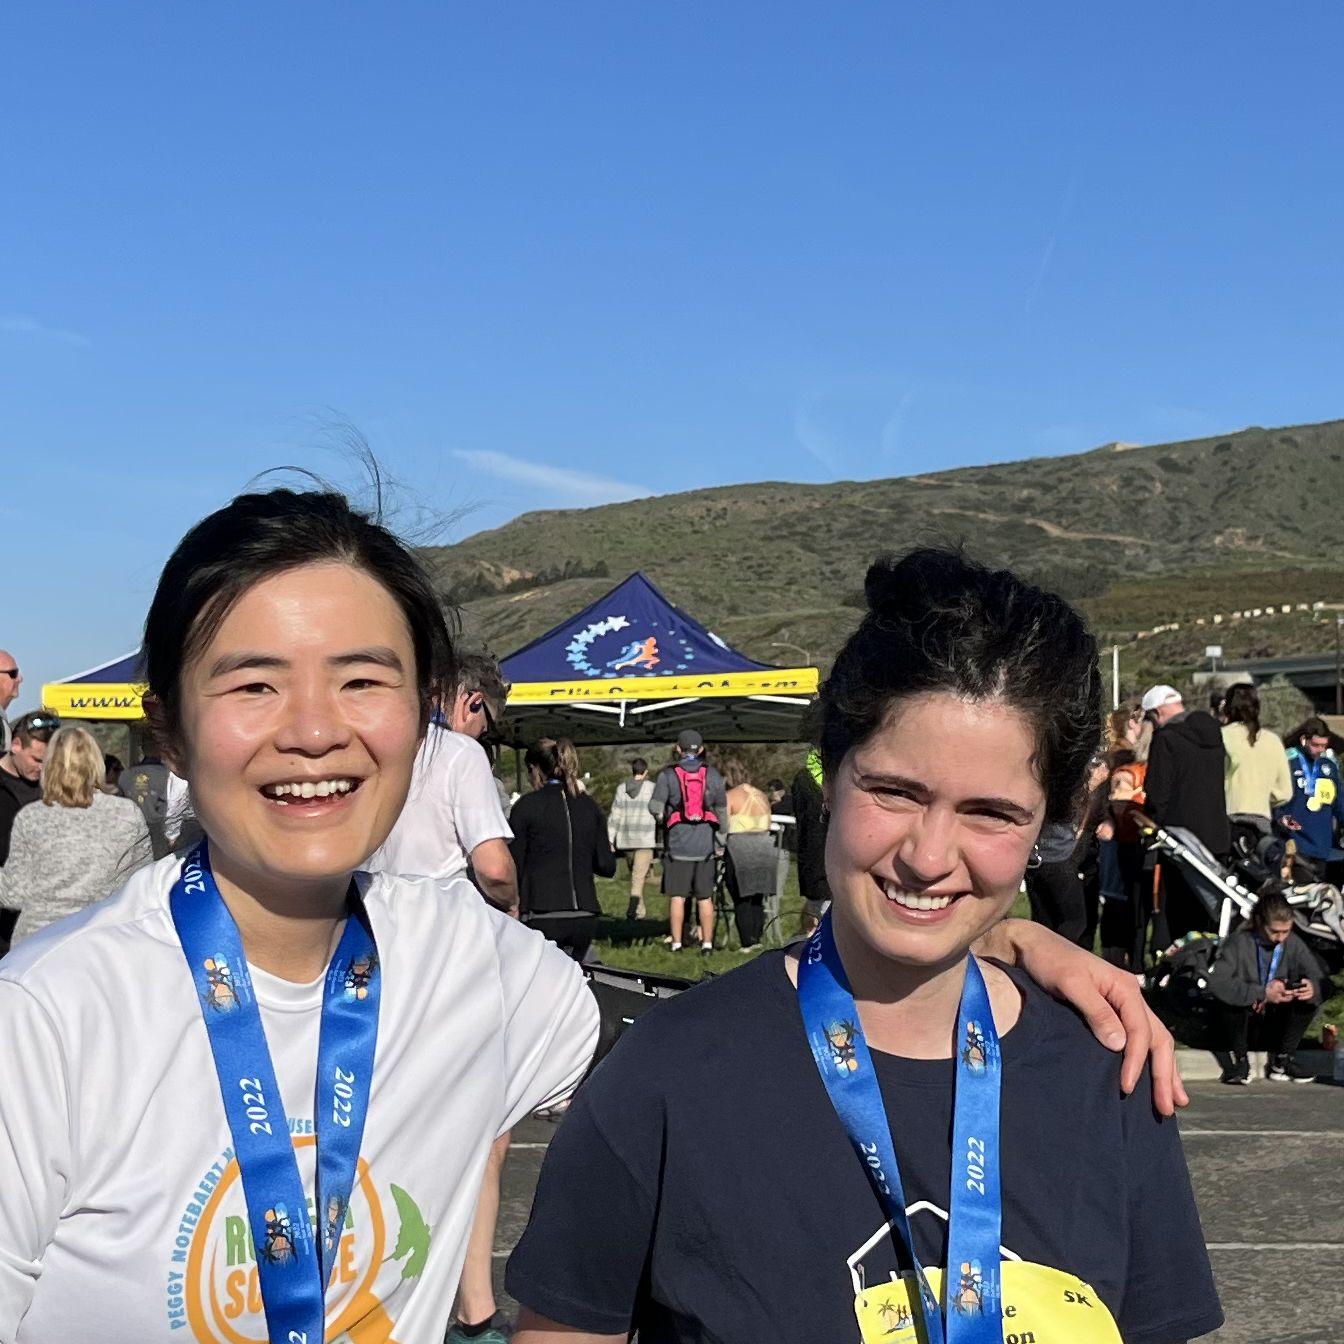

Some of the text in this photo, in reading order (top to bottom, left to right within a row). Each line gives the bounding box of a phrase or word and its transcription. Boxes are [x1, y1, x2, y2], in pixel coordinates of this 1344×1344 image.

[70, 697, 136, 708] www
[808, 921, 823, 965] 022
[240, 1077, 273, 1137] 2022
[333, 1066, 355, 1129] 2022
[967, 1136, 985, 1196] 2022
[171, 1162, 226, 1262] NOTEBAERT
[167, 1271, 187, 1330] PEGGY
[1064, 1290, 1094, 1308] 5K
